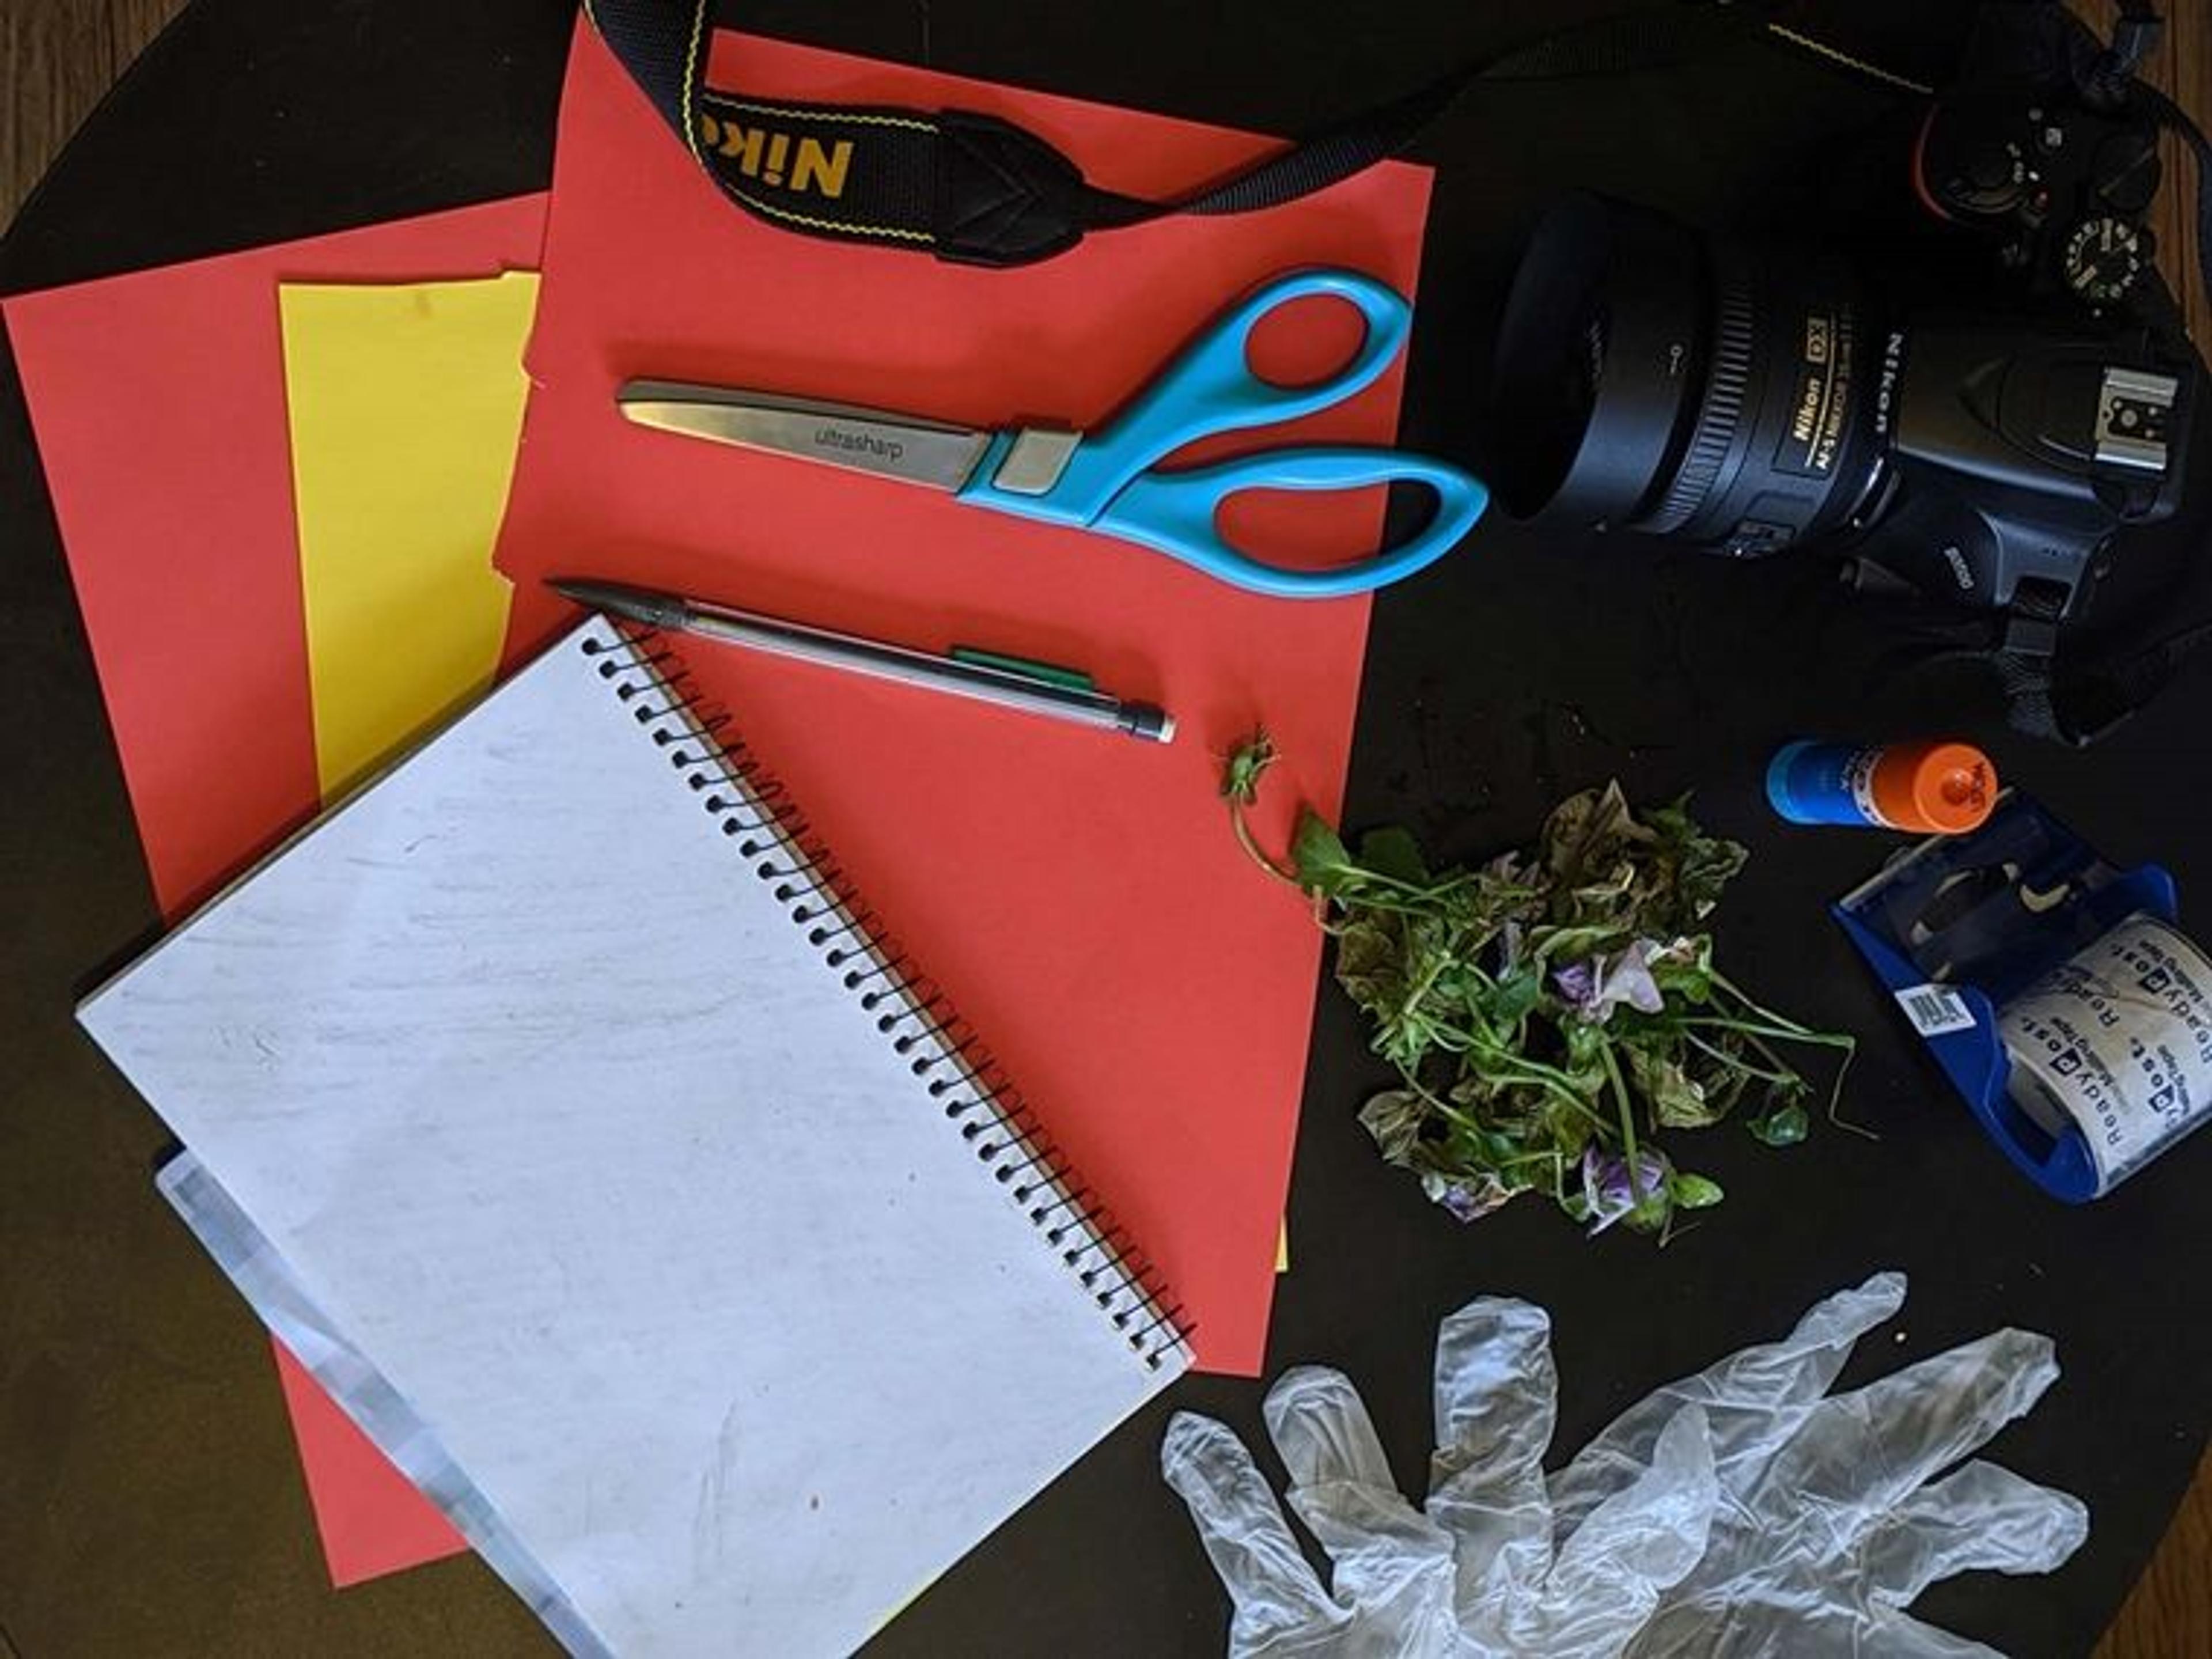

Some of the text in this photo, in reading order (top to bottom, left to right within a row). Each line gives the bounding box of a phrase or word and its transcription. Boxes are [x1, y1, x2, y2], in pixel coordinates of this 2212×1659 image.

[1793, 322, 1825, 441] Nikon DX
[1876, 333, 1903, 433] Nikon
[815, 427, 904, 462] ultrasharp
